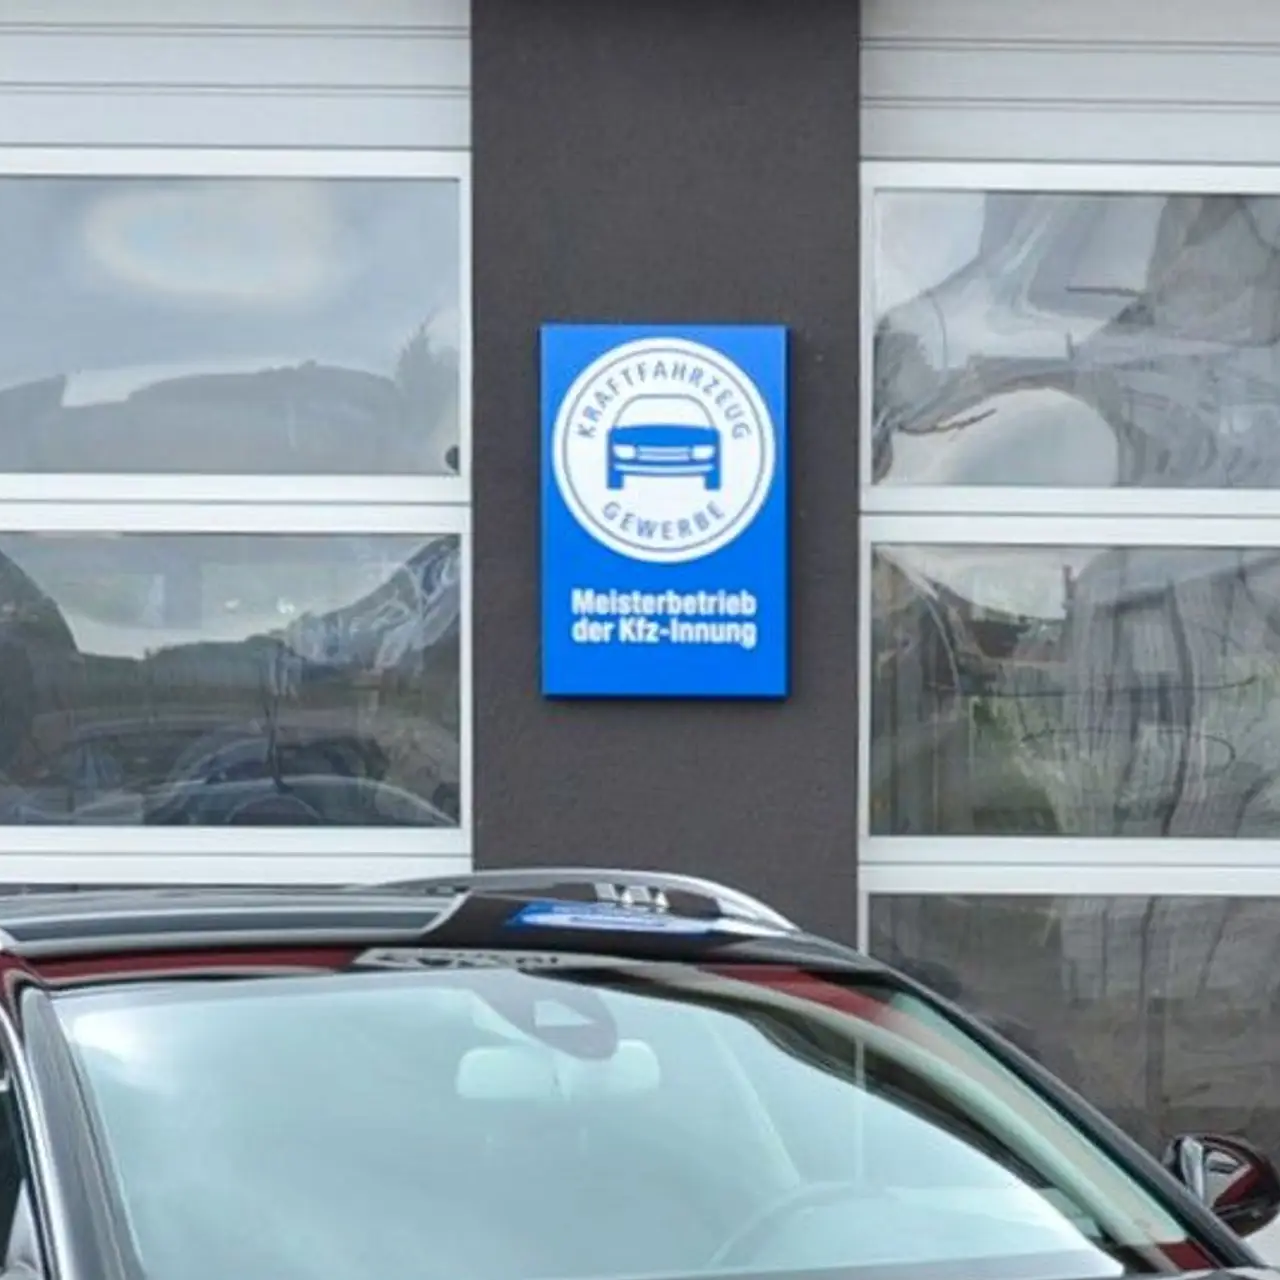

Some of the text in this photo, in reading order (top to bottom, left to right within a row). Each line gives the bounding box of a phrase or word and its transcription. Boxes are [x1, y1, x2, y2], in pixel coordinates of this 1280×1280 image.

[576, 360, 752, 440] KRAFTFAHRZEUG
[601, 500, 726, 542] GEWERBE
[571, 588, 757, 616] Meisterbetrieb
[571, 618, 757, 649] der Kfz-Innung
